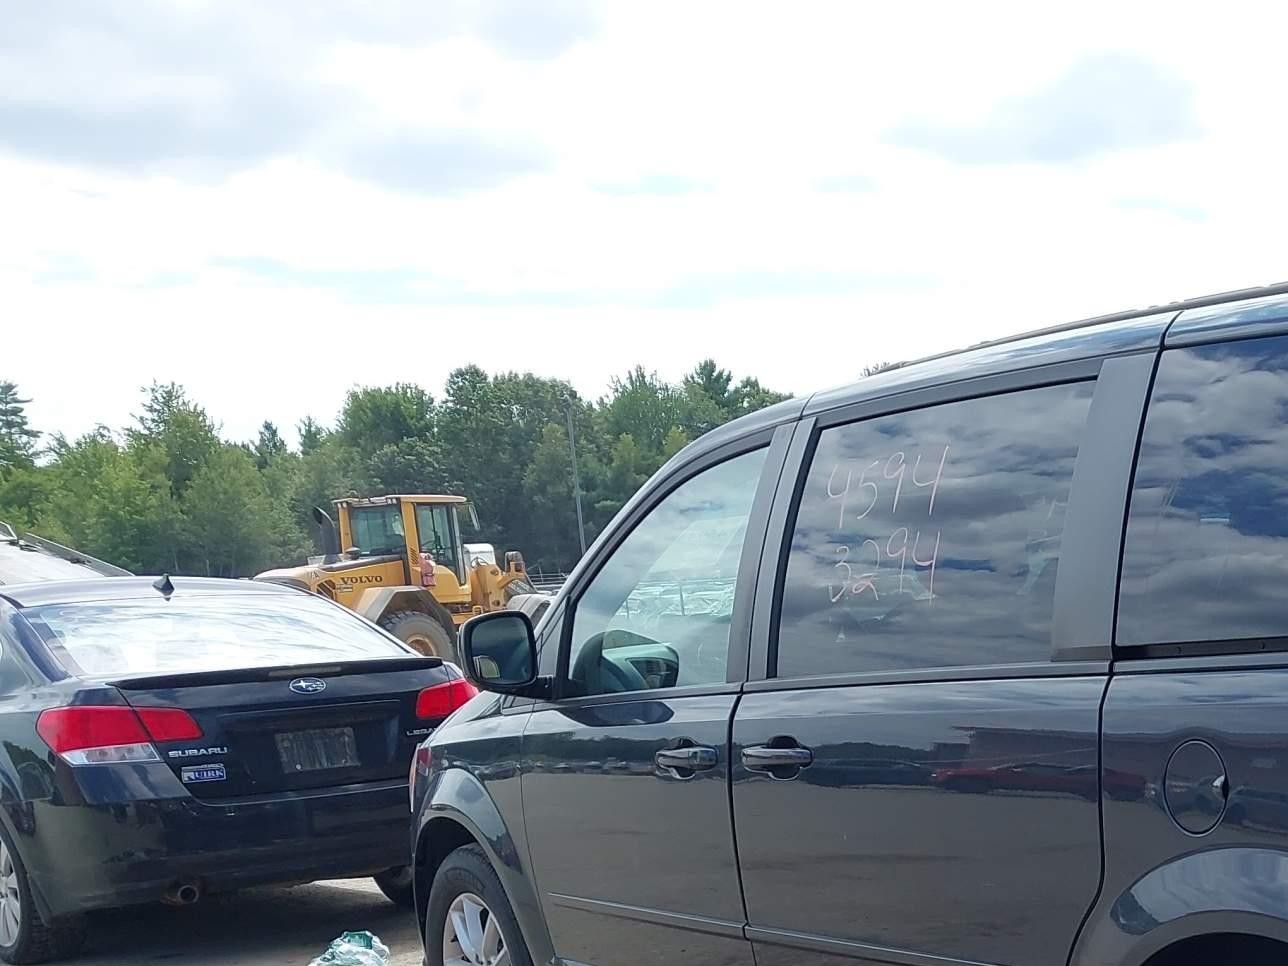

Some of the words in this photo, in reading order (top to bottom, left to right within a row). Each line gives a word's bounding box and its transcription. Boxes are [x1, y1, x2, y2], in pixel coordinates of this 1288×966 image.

[827, 445, 950, 529] 4594
[340, 575, 384, 586] VOLVO
[168, 746, 228, 758] SUBARU
